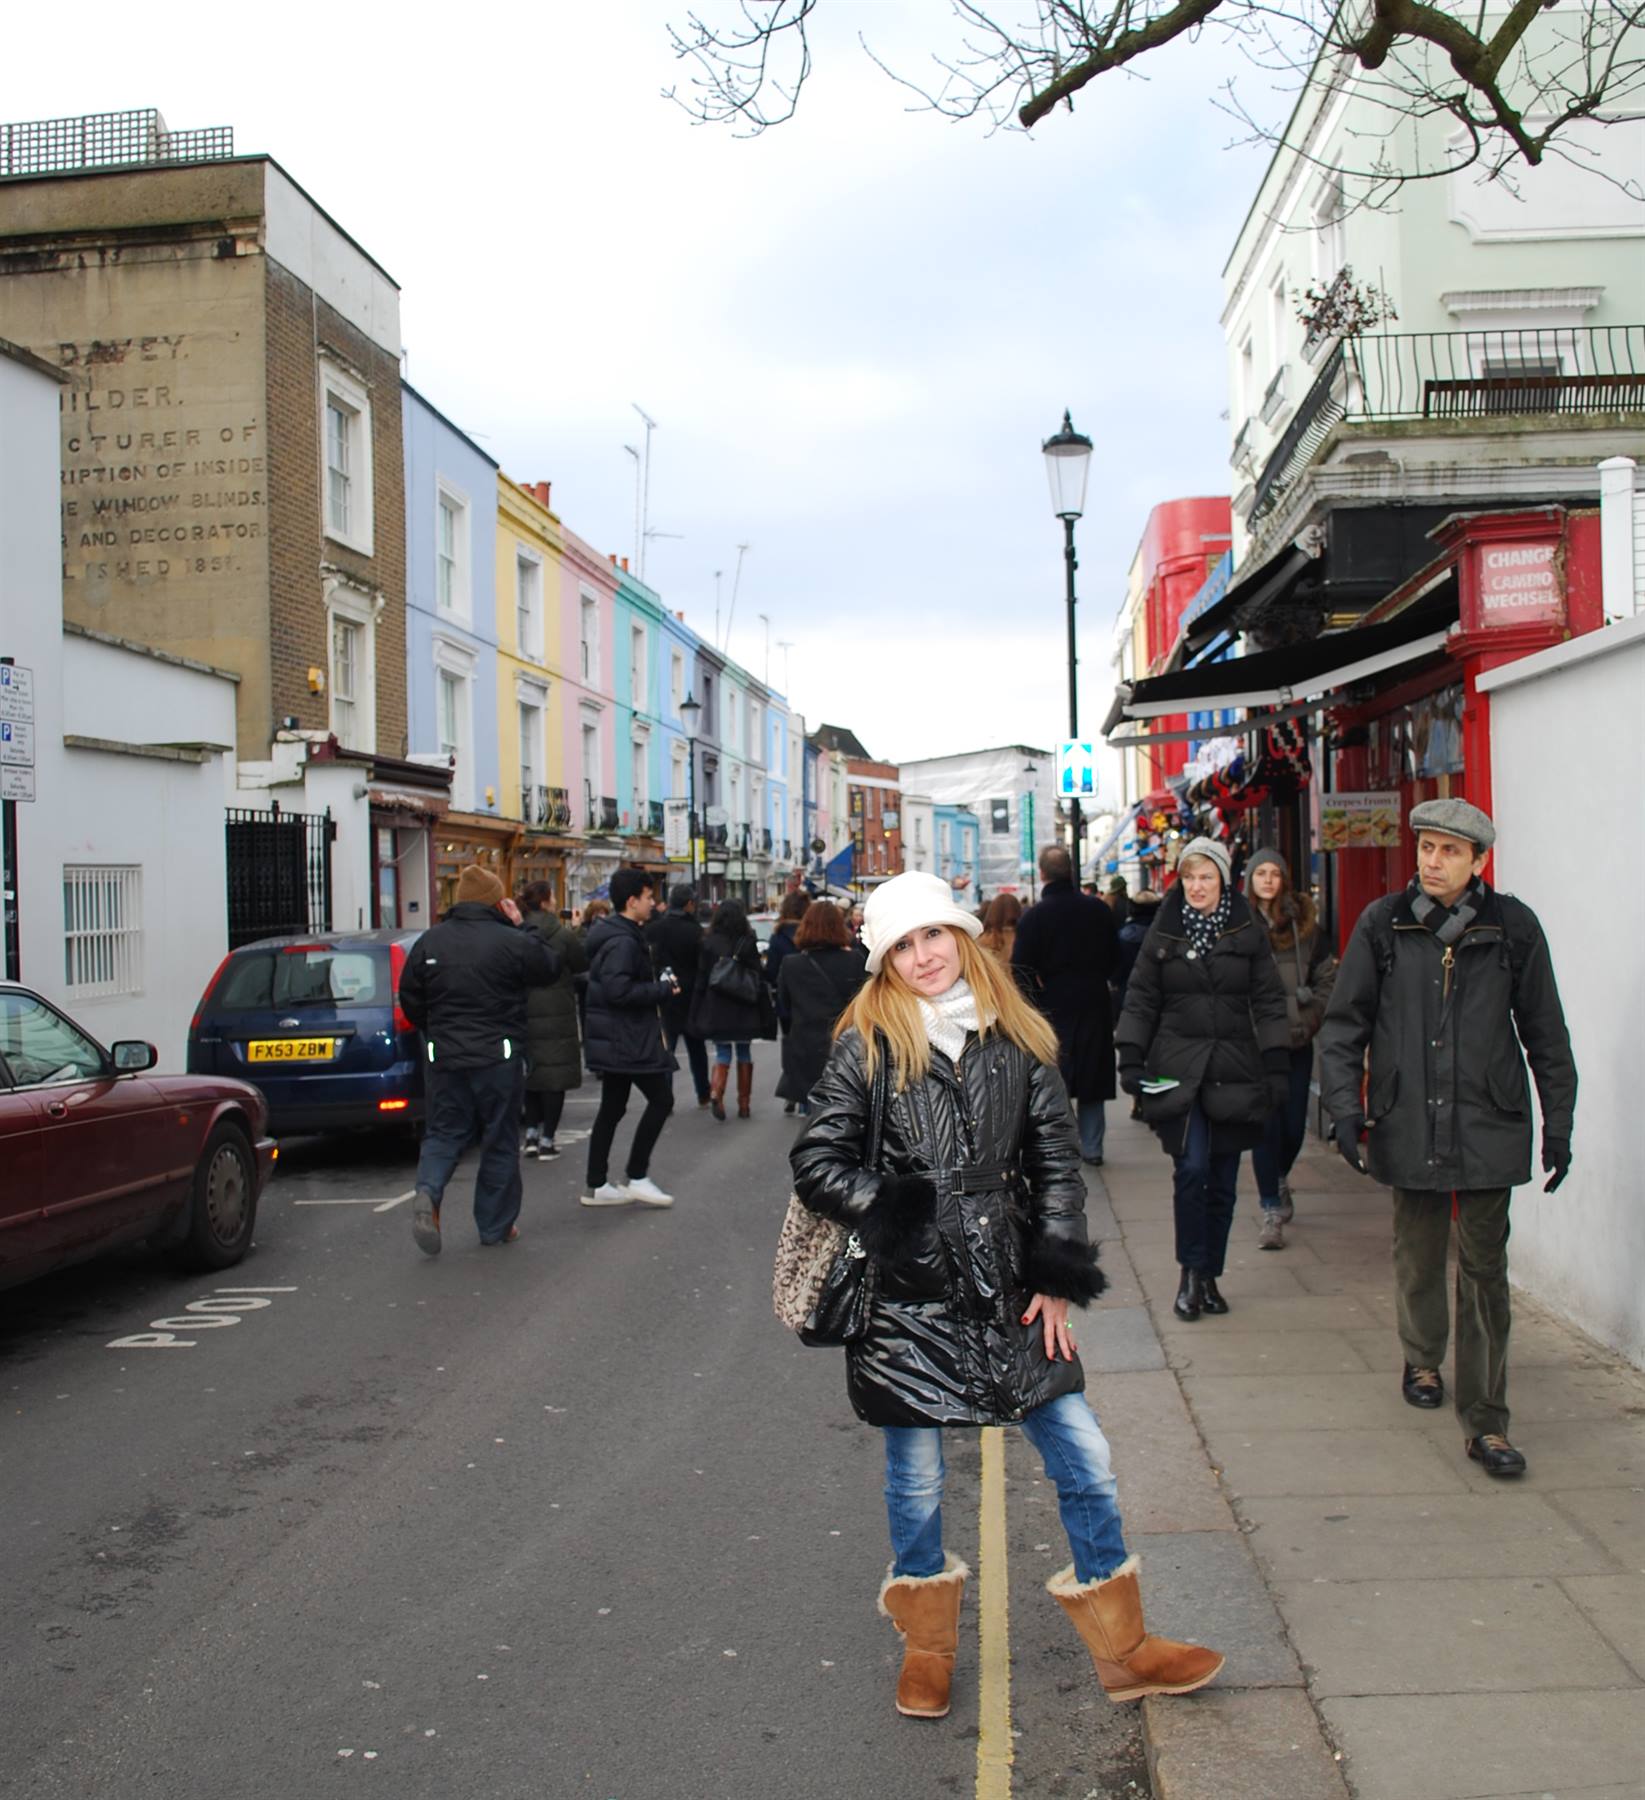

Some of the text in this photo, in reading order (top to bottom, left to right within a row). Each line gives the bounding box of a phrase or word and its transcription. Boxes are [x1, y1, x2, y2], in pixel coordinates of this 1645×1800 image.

[219, 426, 257, 443] OF
[156, 462, 187, 479] OF
[194, 457, 265, 476] INSIDE
[93, 494, 180, 515] WINDOW
[80, 531, 117, 548] AND
[1483, 591, 1559, 608] WECHSEL
[1364, 796, 1392, 806] from
[255, 1043, 327, 1058] FX53 ZBW
